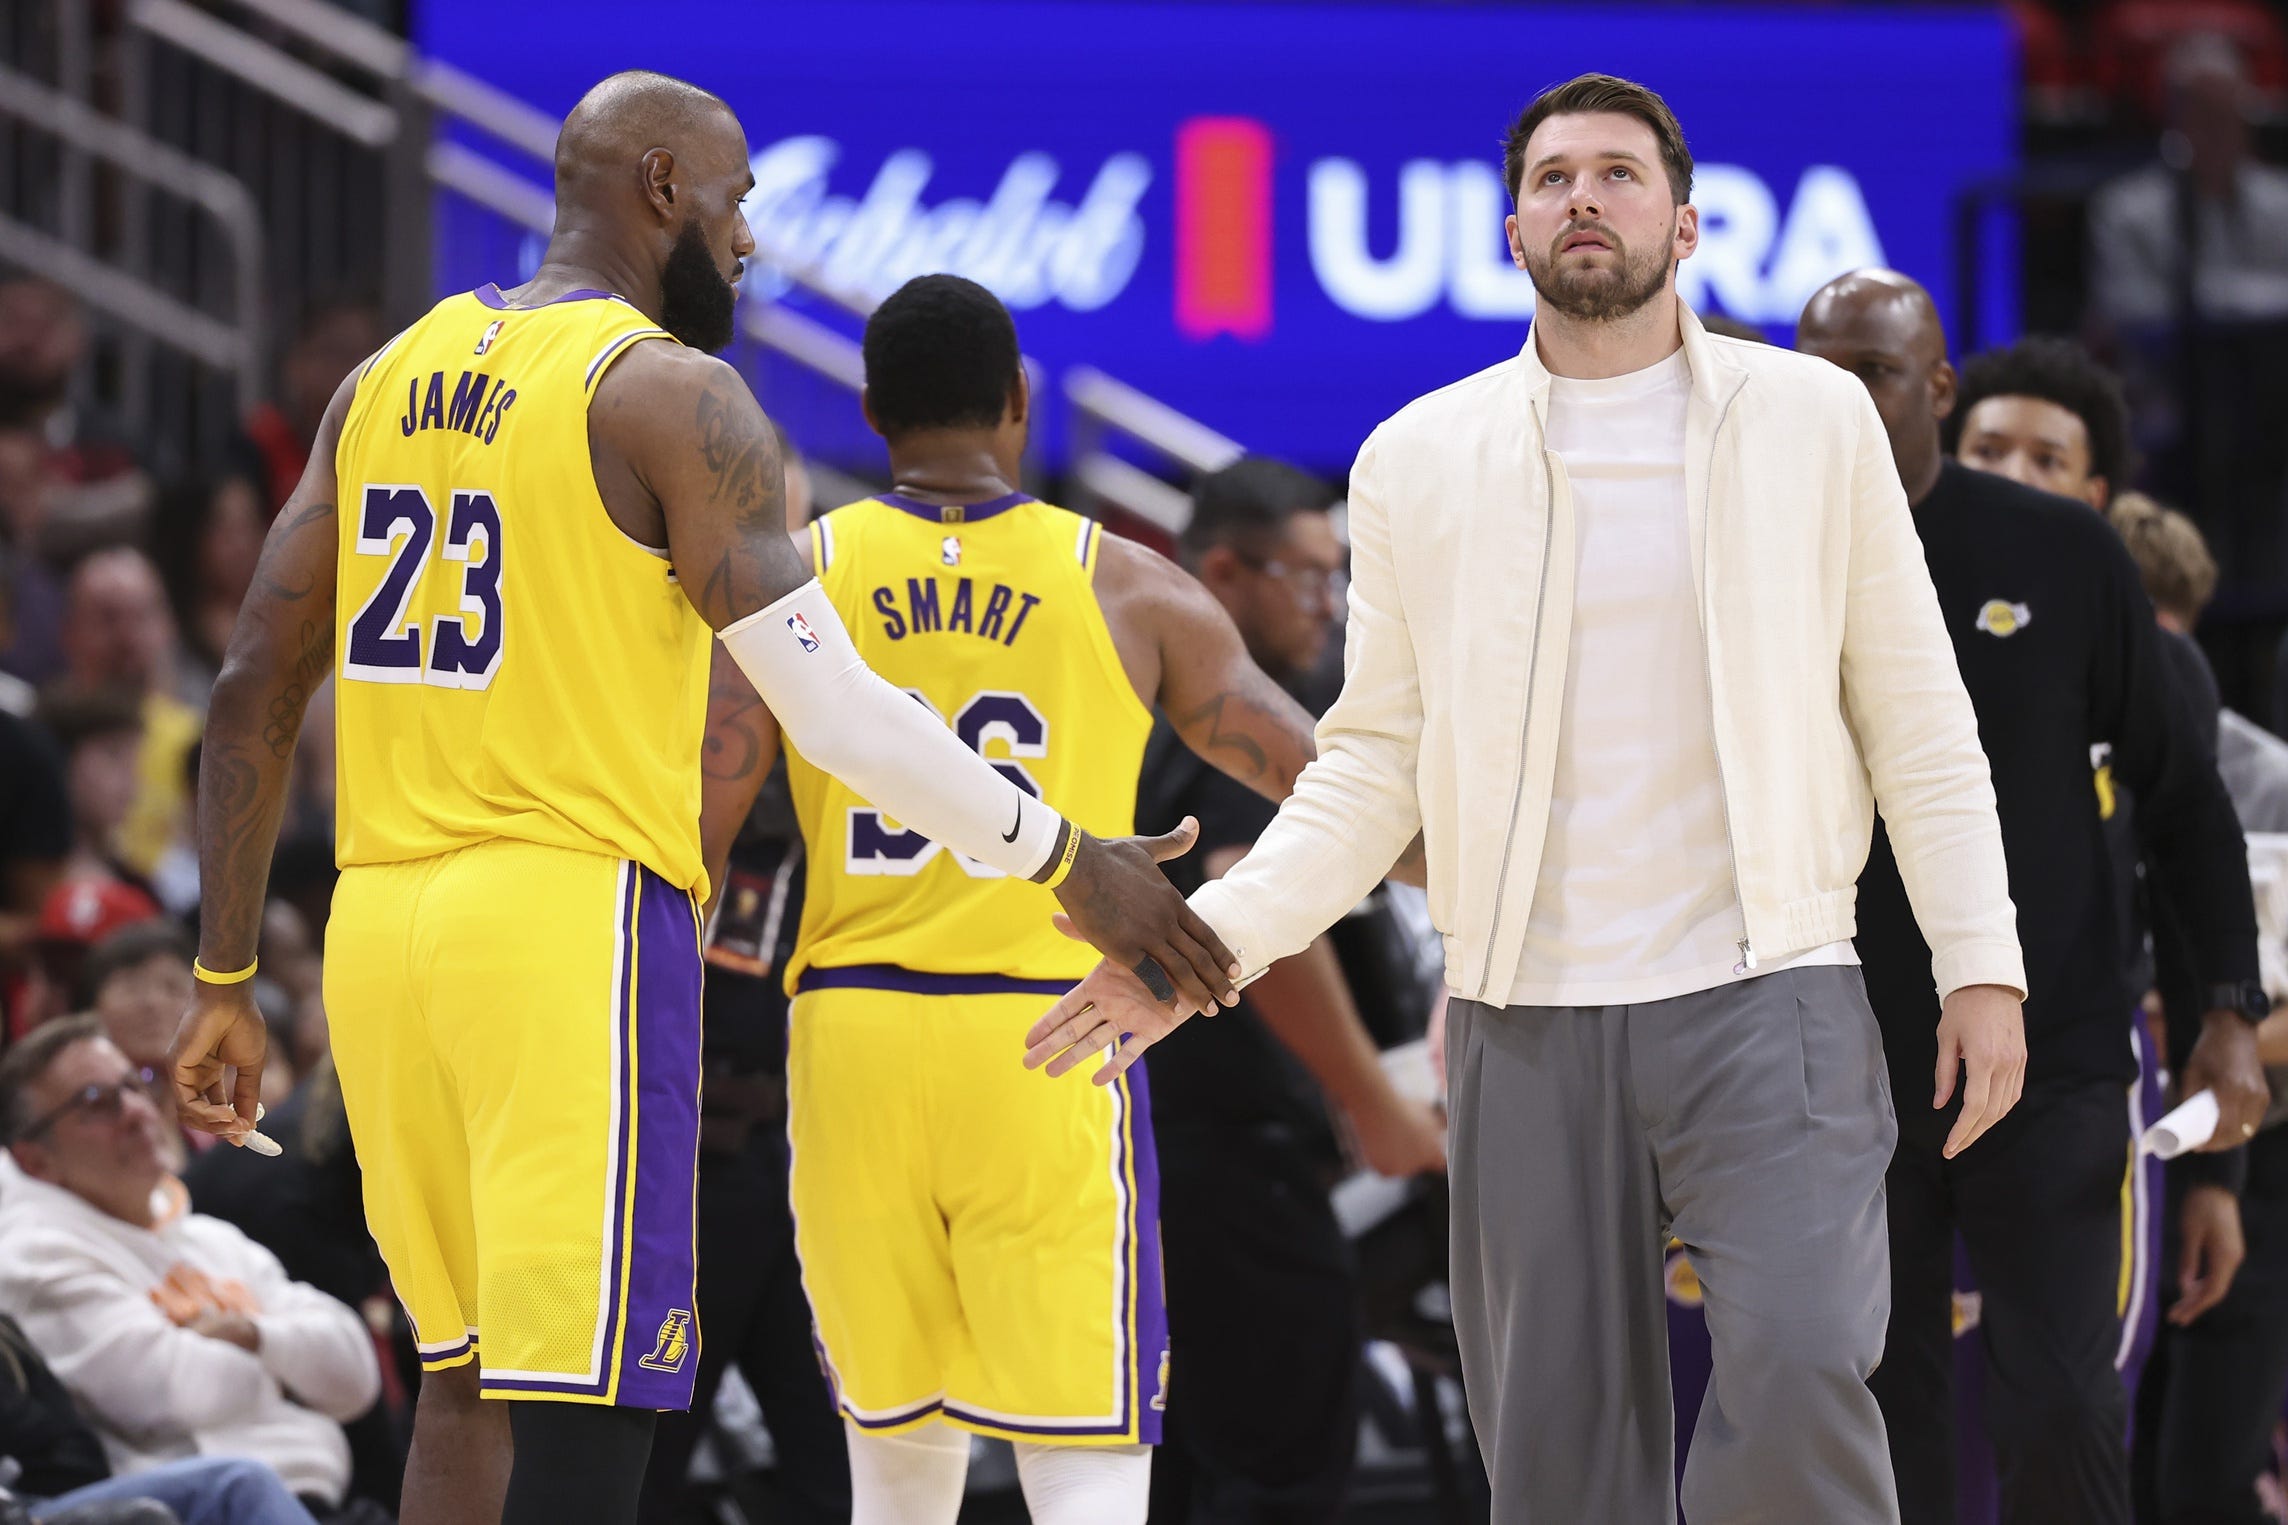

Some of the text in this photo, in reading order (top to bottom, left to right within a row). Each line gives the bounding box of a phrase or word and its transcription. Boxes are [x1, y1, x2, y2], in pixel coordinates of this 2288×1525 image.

[1304, 156, 1889, 322] ULRA
[401, 371, 517, 446] JAMES
[343, 483, 505, 692] 23
[872, 577, 1042, 647] SMART
